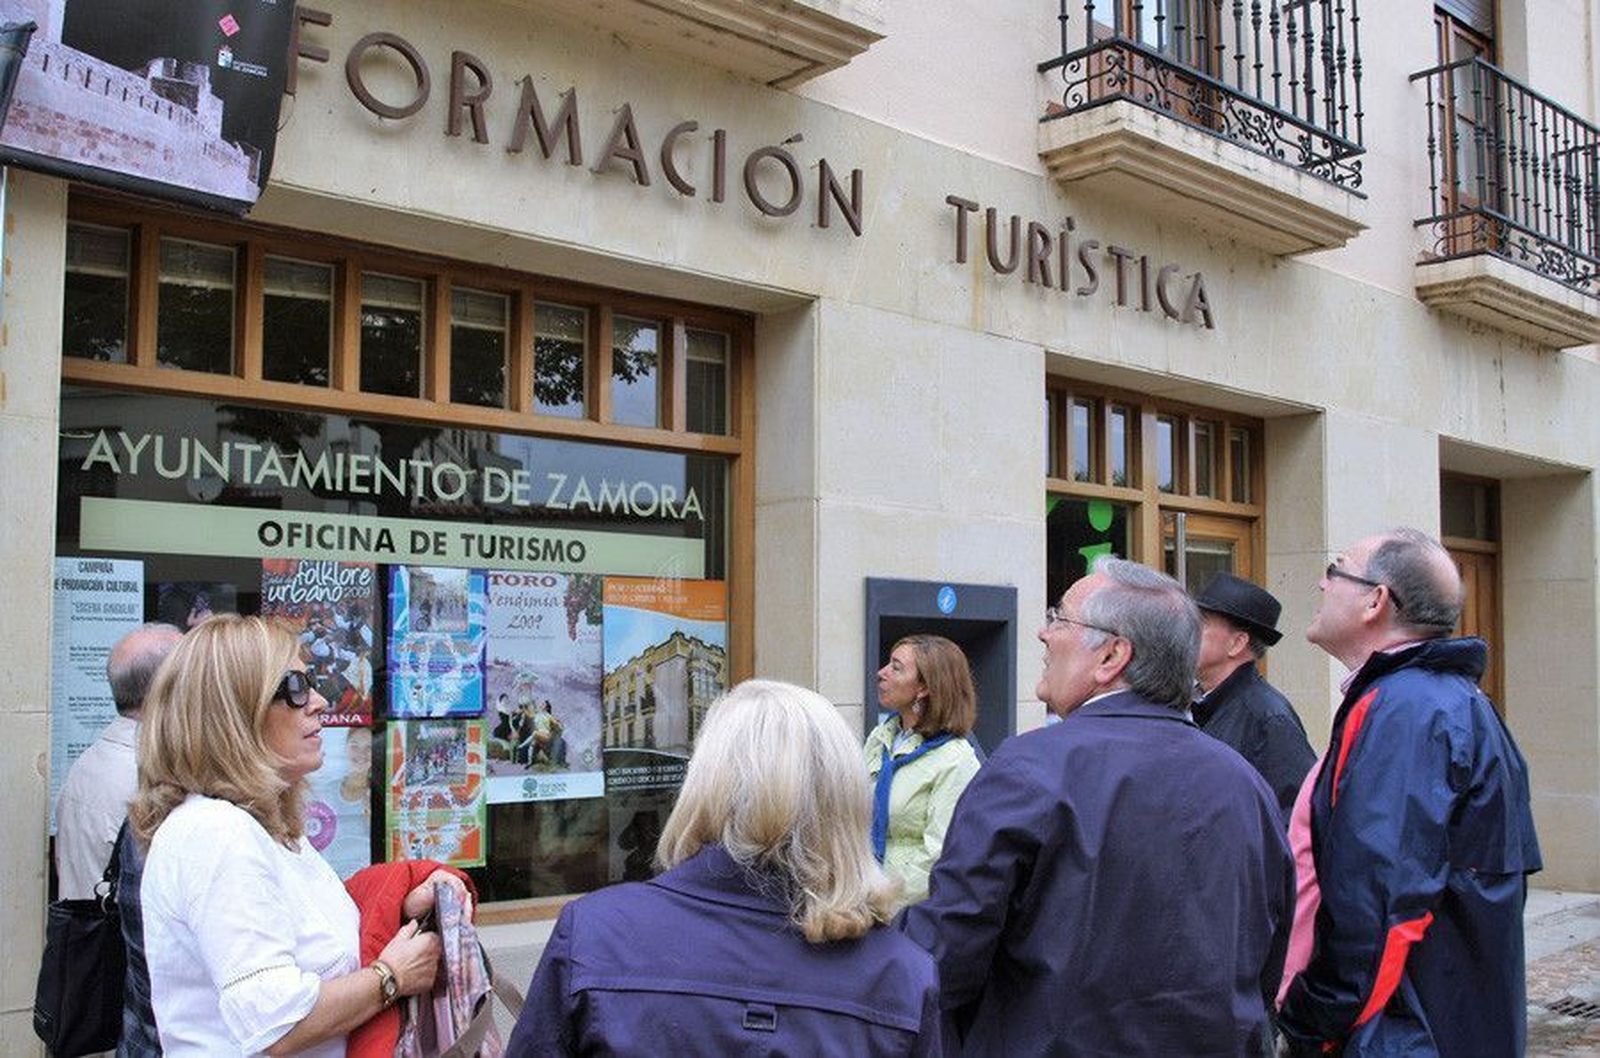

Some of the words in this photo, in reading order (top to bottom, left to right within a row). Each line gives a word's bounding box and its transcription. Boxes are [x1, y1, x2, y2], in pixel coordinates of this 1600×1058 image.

[282, 5, 864, 238] FORMACIÓN
[945, 195, 1215, 330] TURÍSTICA
[81, 429, 468, 502] AYUNTAMIENTO
[483, 467, 531, 506] DE
[546, 472, 705, 521] ZAMORA
[258, 521, 396, 554] OFICINA
[409, 530, 448, 557] DE
[460, 532, 586, 563] TURISMO
[297, 560, 372, 586] folklore
[489, 574, 557, 588] TORO
[267, 577, 343, 604] urbano
